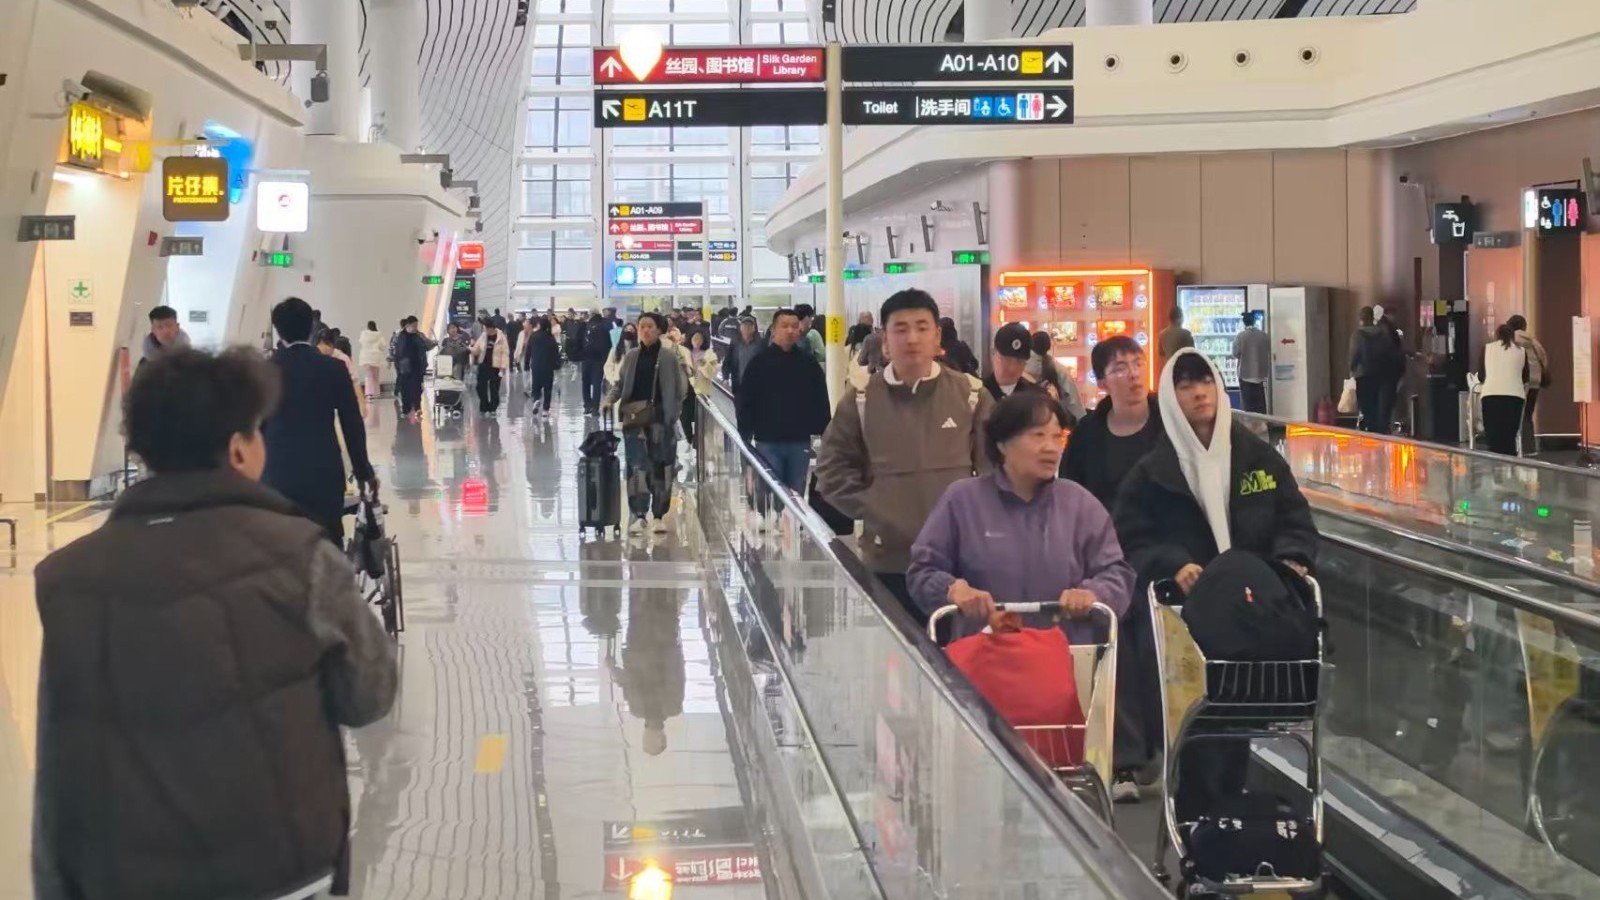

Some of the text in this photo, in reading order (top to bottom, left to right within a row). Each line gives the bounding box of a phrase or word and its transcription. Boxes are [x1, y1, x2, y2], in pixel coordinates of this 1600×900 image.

[665, 57, 755, 75] 丝园、图书馆
[762, 54, 817, 64] Silk Garden
[940, 54, 1019, 72] A01-A10
[773, 65, 807, 76] Library
[648, 100, 698, 118] A11T
[863, 101, 898, 114] Toilet
[920, 99, 971, 116] 洗手间
